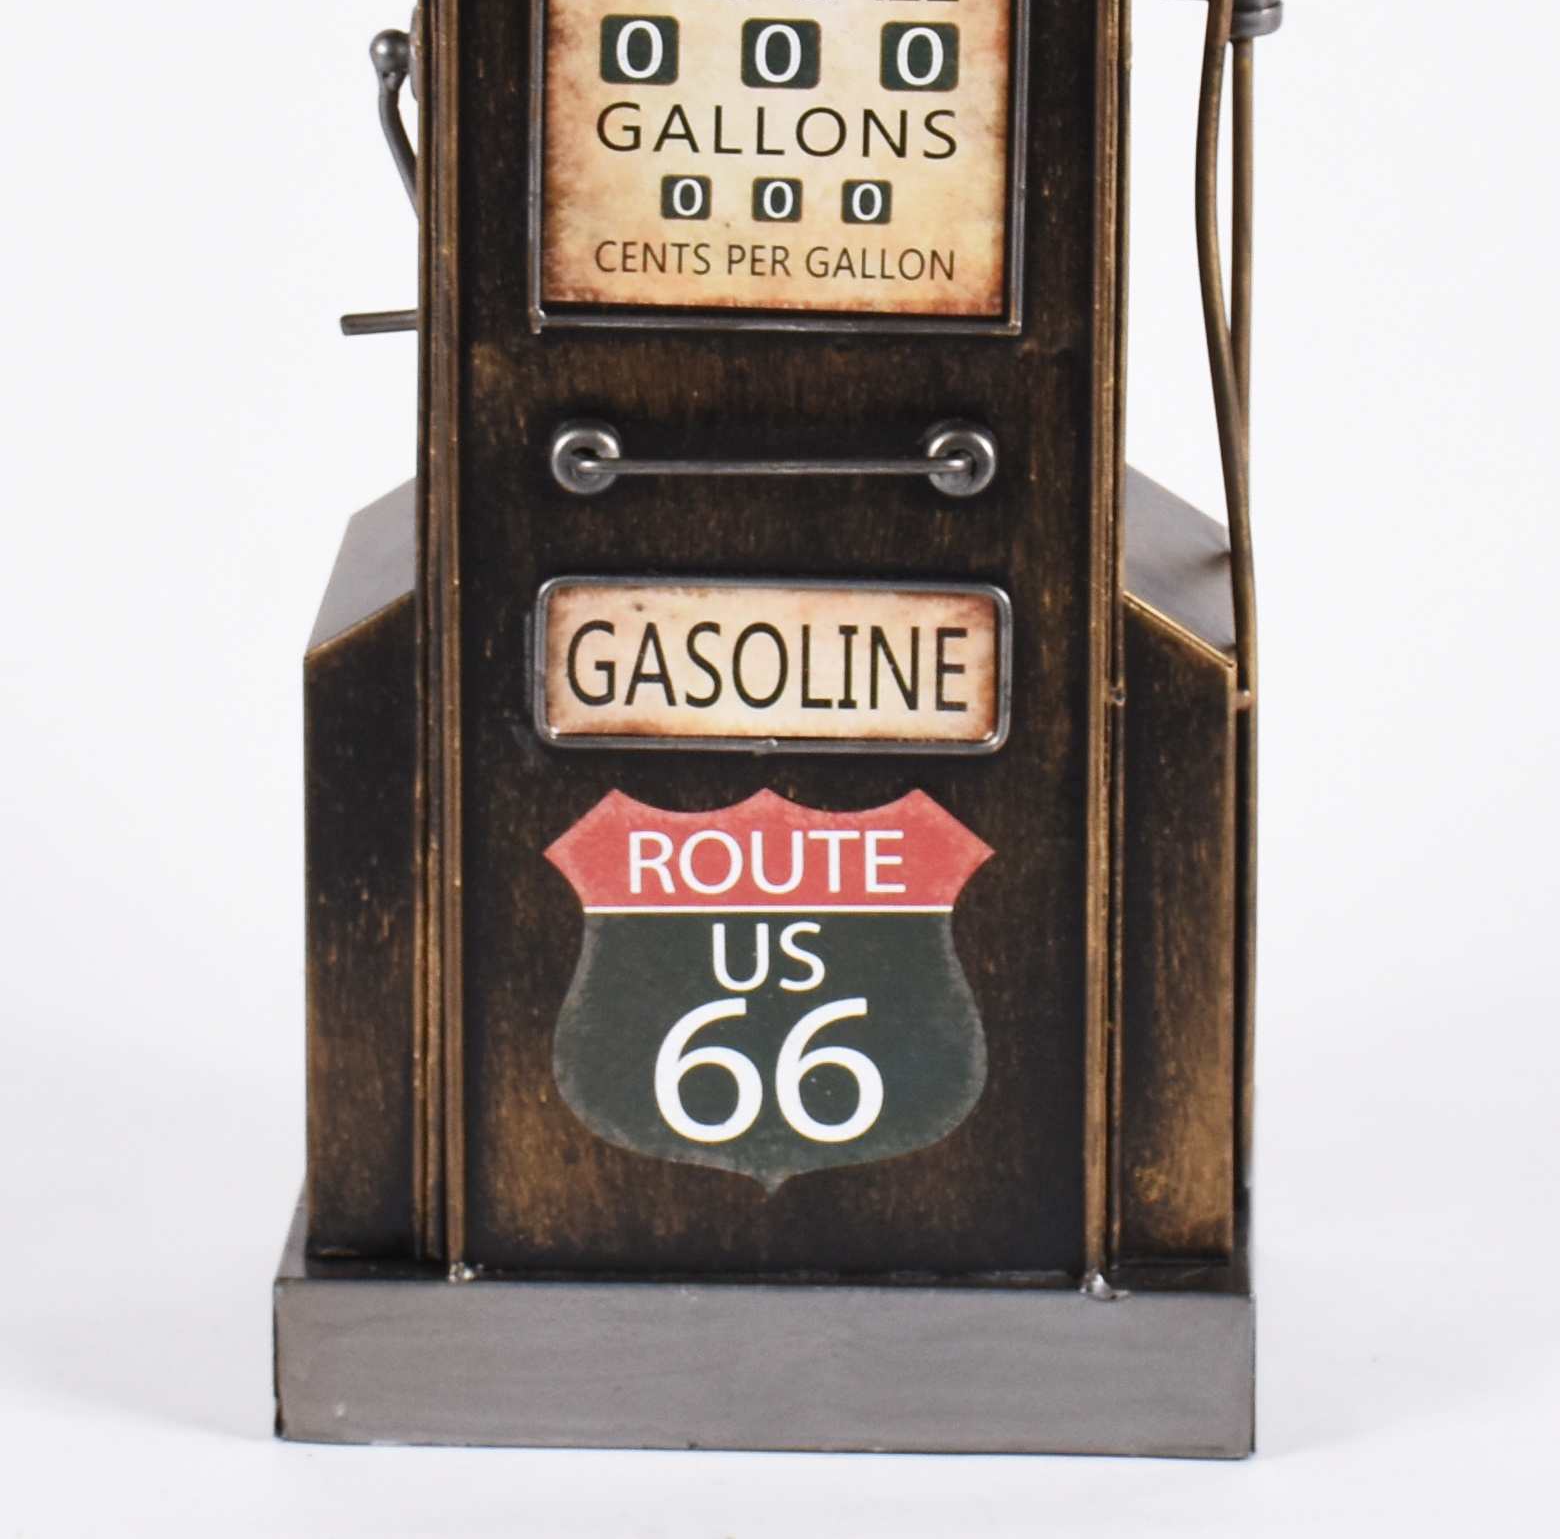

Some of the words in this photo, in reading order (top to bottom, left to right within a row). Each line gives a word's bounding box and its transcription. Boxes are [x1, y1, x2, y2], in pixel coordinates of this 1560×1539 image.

[616, 20, 664, 79] 0
[755, 24, 802, 83] 0
[897, 27, 944, 86] 0
[596, 101, 957, 160] GALLONS
[672, 179, 703, 217] 0
[763, 180, 794, 219] 0
[852, 182, 883, 221] 0
[595, 240, 711, 276] CENTS
[727, 244, 791, 277] PER
[805, 246, 955, 282] GALLON
[566, 619, 968, 713] GASOLINE
[628, 830, 906, 894] ROUTE
[712, 921, 826, 992] US
[654, 996, 884, 1144] 66
